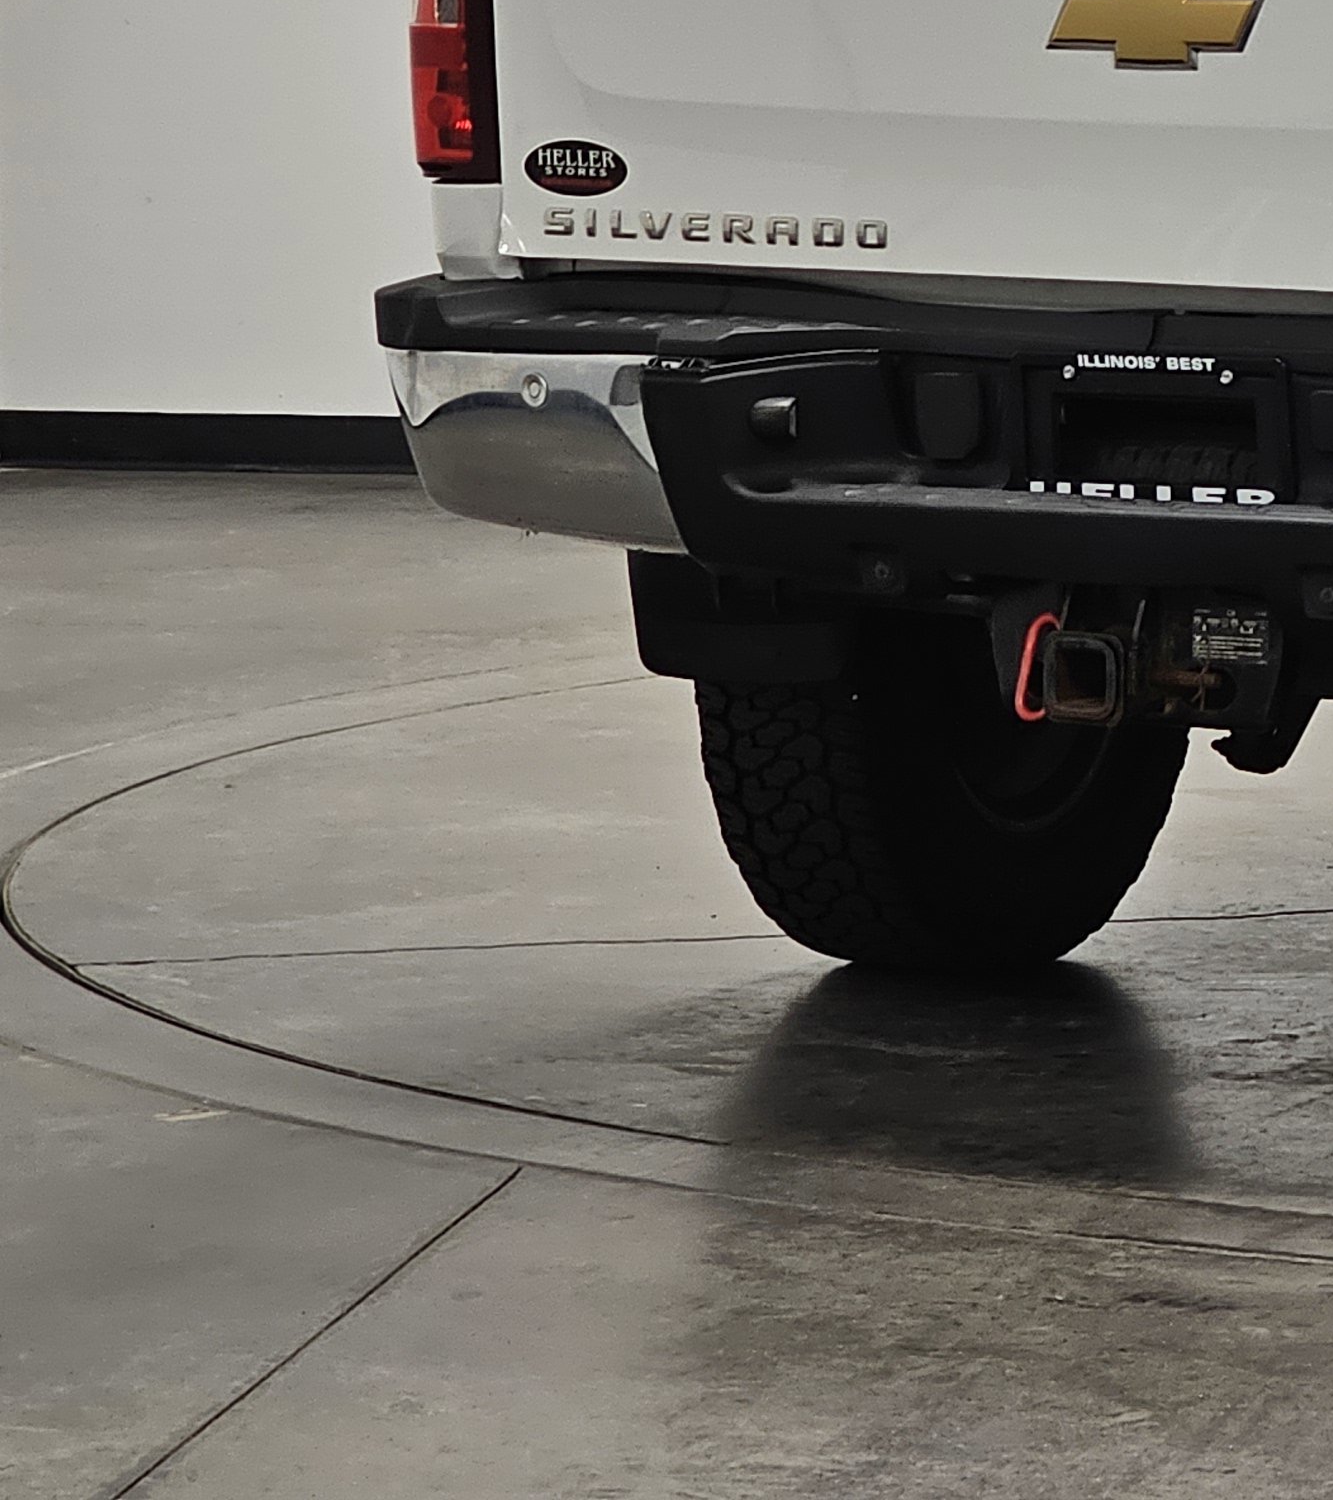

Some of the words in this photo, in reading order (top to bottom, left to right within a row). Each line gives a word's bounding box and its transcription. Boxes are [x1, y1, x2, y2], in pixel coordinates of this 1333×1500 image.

[537, 148, 616, 169] HELLER
[544, 166, 608, 178] STORES
[543, 206, 888, 250] SILVERADO
[1077, 353, 1161, 370] ILLINOIS'
[1166, 356, 1216, 372] BEST
